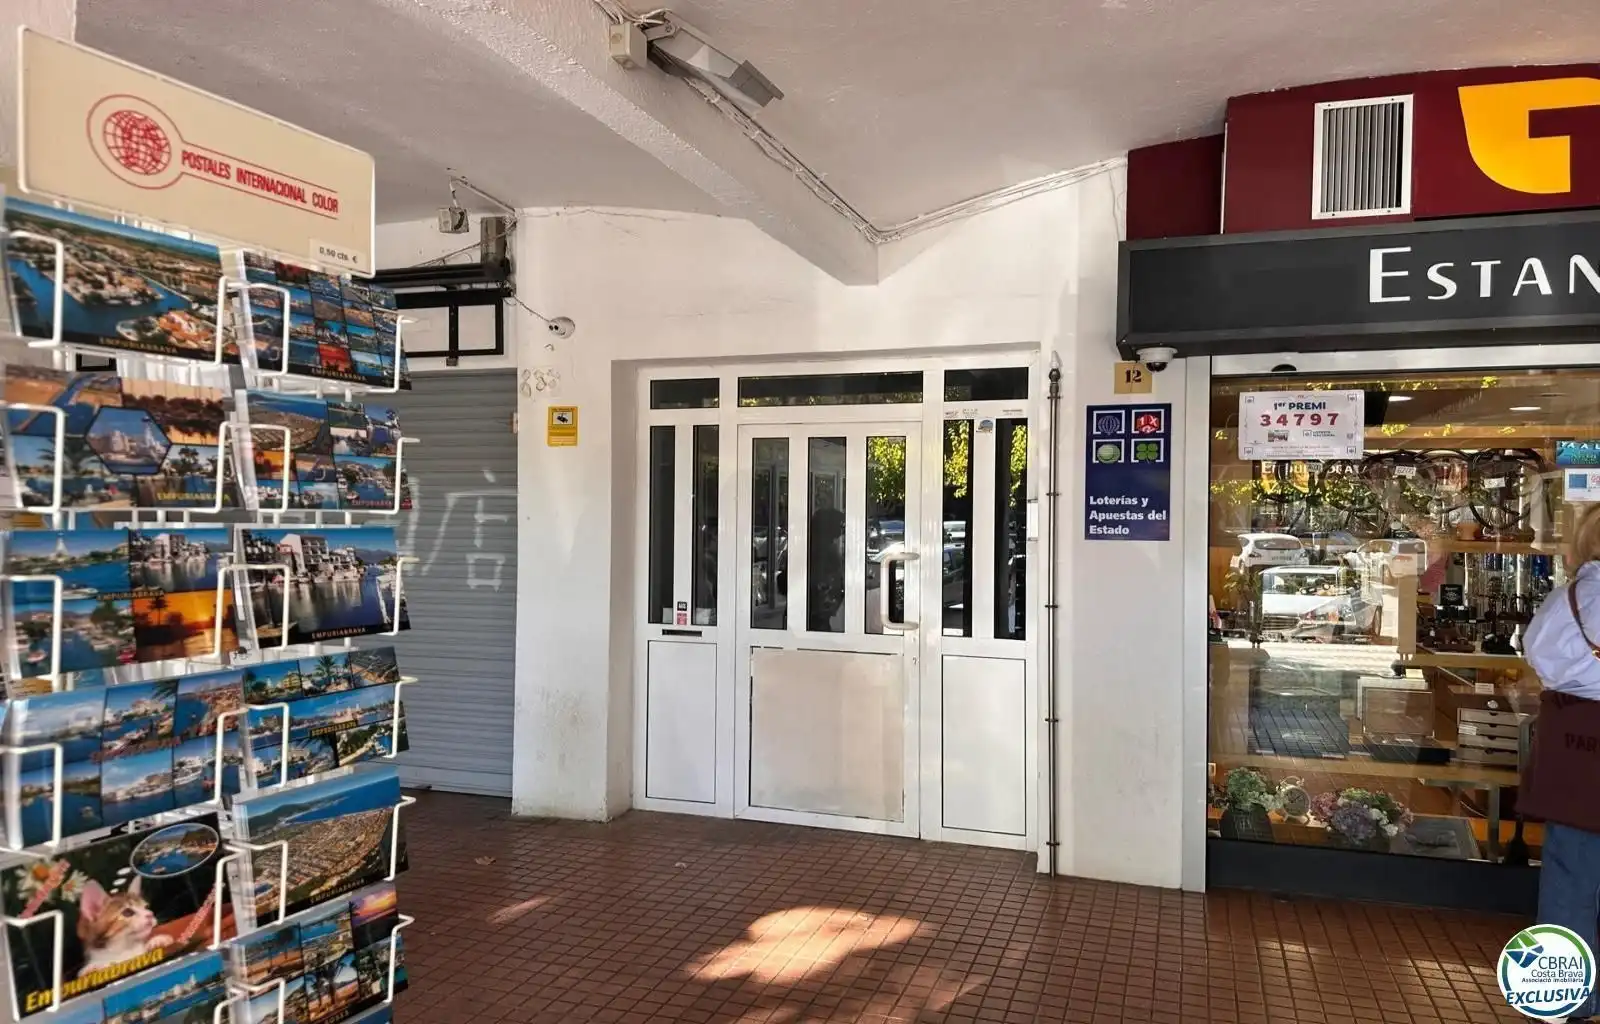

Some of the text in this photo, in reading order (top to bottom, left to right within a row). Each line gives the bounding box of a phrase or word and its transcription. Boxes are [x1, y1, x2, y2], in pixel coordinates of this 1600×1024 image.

[181, 150, 338, 213] POSTALES INTERNACIONAL COLOR
[1369, 246, 1600, 303] ESTAN
[1125, 369, 1142, 383] 12
[1288, 401, 1327, 411] PREMI
[1089, 496, 1149, 507] Loterías y
[1089, 510, 1167, 523] Apuestas del
[1089, 525, 1130, 535] Estado
[311, 627, 366, 639] EMPURIABRAVA
